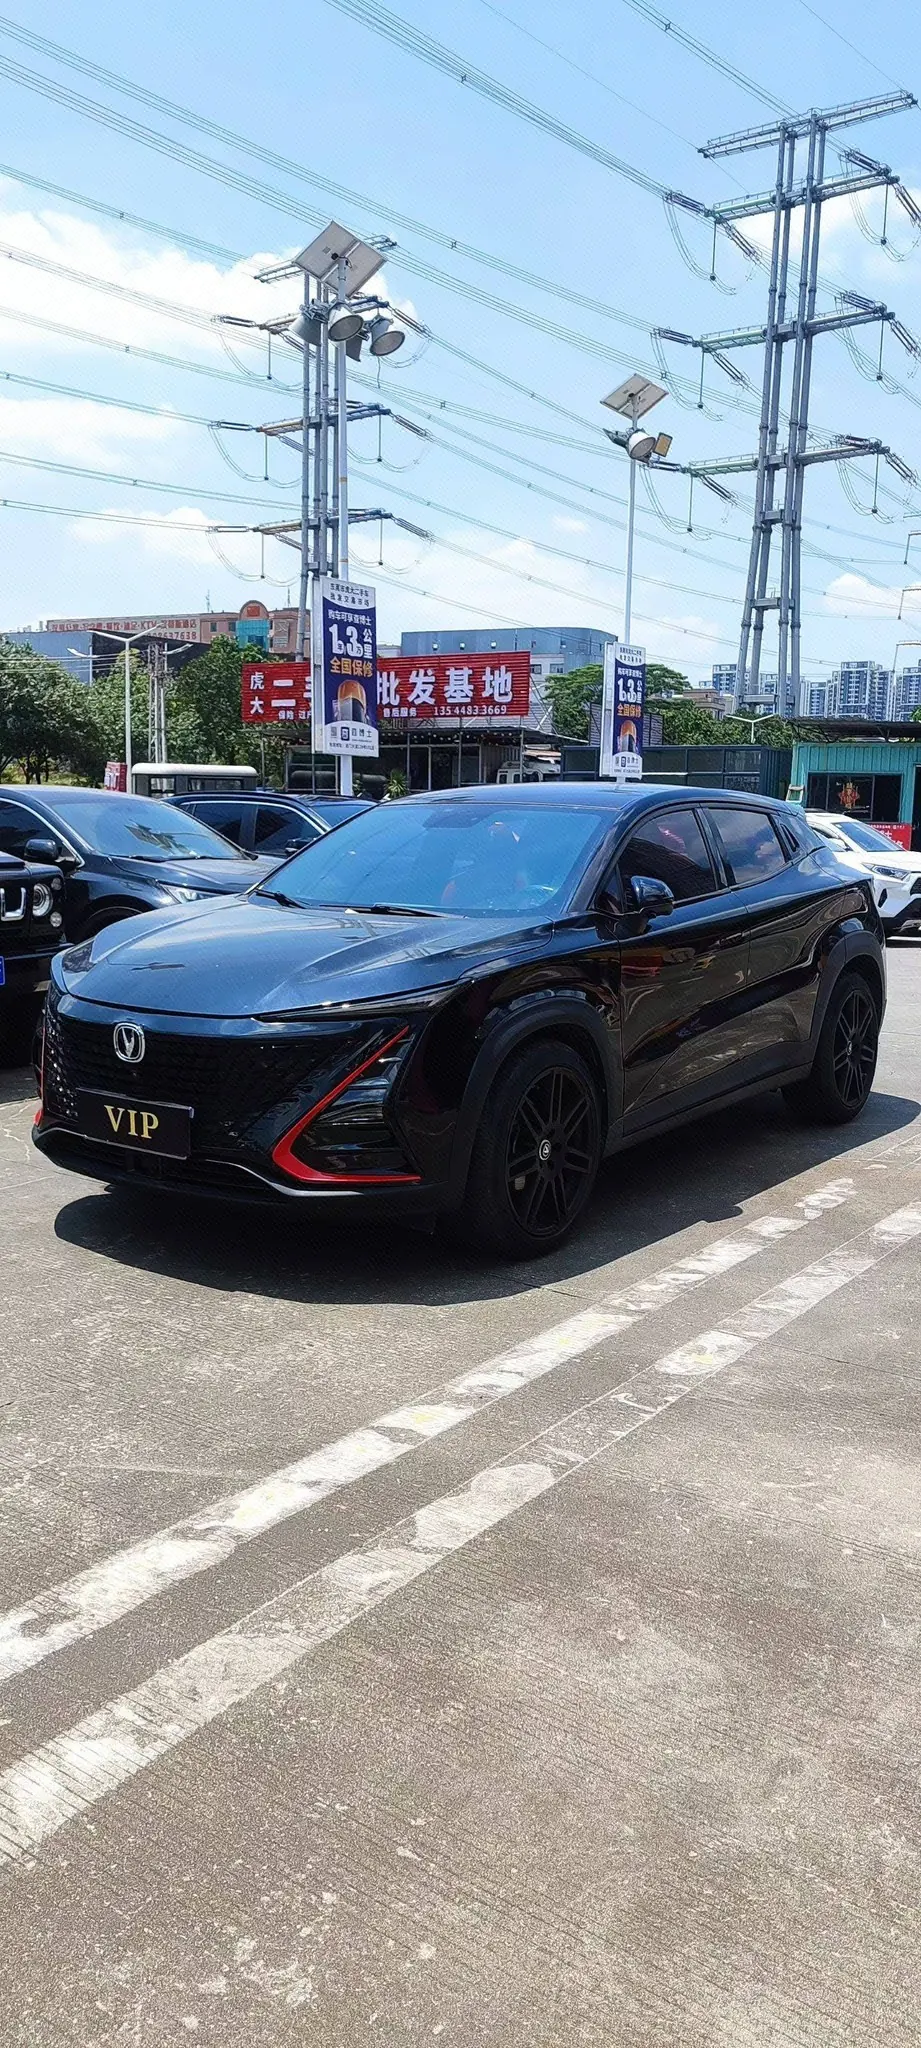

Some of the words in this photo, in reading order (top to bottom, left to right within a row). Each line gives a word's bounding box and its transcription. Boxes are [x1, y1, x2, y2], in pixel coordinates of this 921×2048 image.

[330, 656, 373, 678] 全国保修
[377, 665, 513, 706] 批发基地
[104, 1104, 159, 1139] VIP
